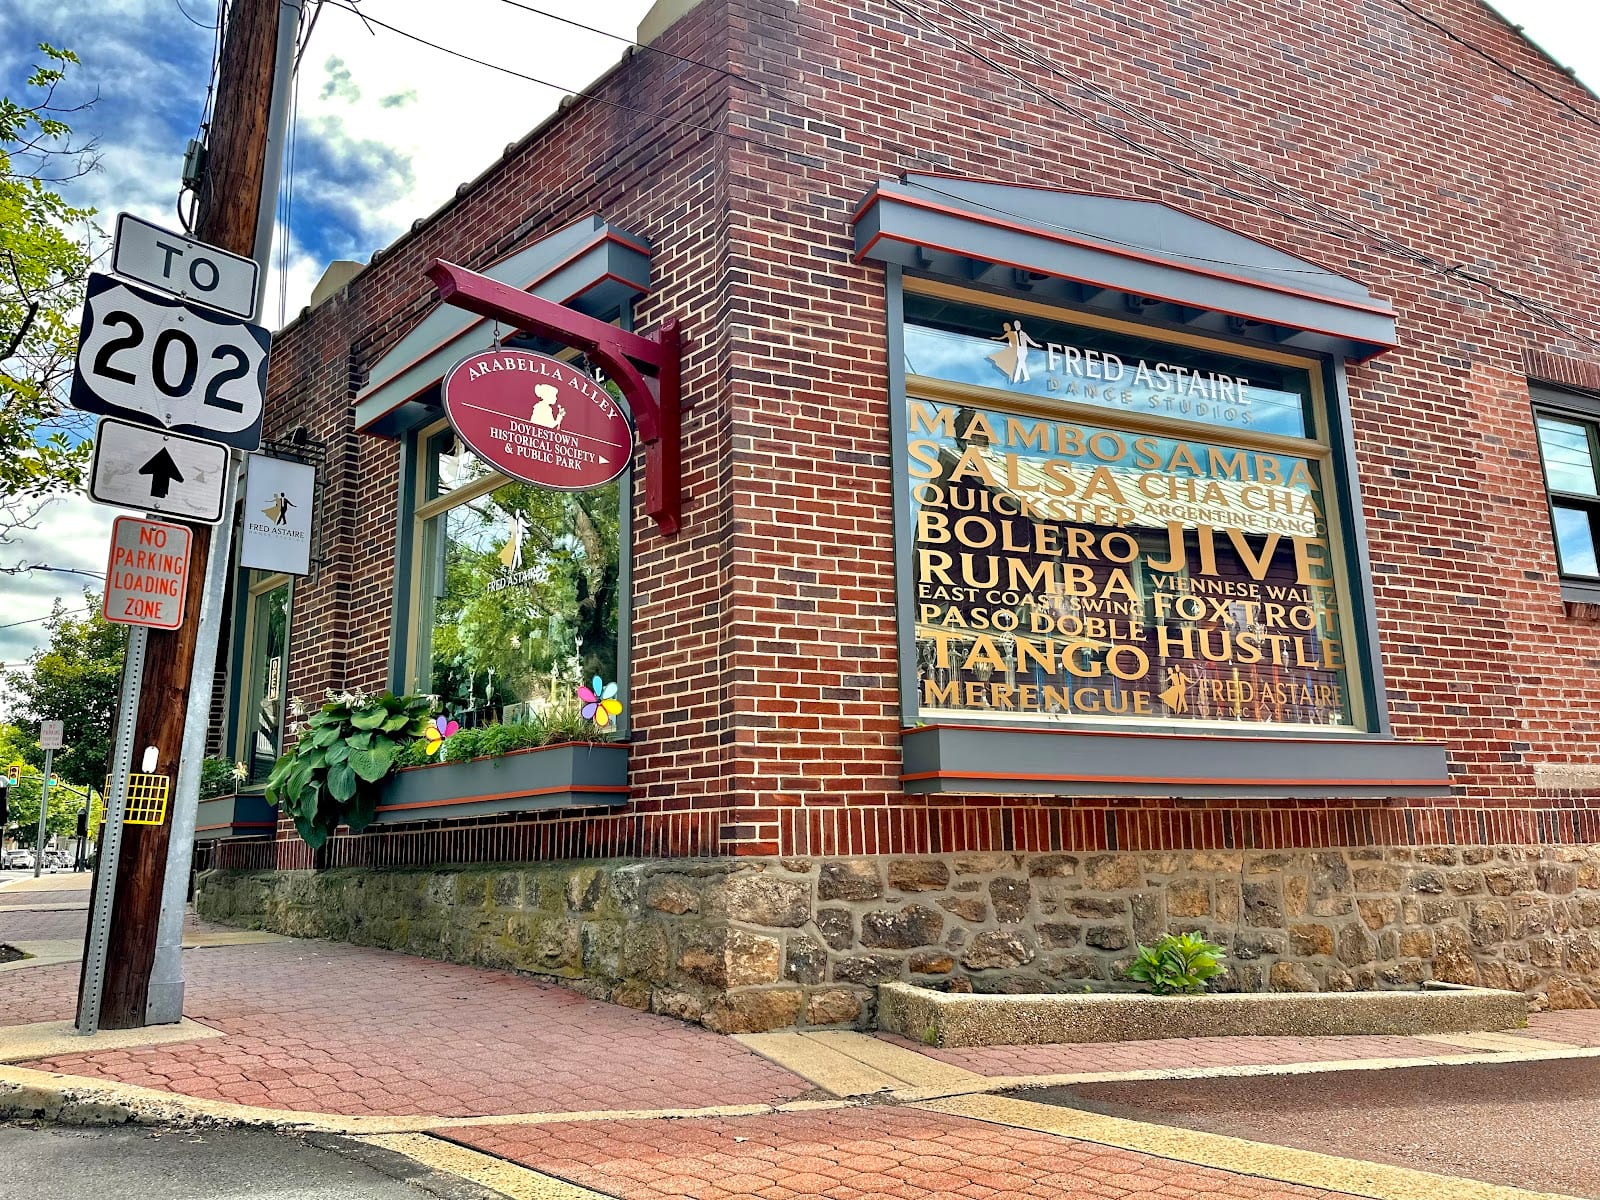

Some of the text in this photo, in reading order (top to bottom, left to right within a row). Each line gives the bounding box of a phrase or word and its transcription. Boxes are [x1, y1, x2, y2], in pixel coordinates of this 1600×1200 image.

[156, 241, 220, 292] TO
[93, 310, 250, 414] 202
[1047, 342, 1252, 405] FRED ASTAIRE
[468, 357, 563, 382] ARABELLA
[568, 377, 618, 420] ALLEY
[1047, 376, 1254, 424] DANCE STUDIOS
[490, 427, 595, 463] HISTORICAL SOCIETY
[510, 421, 579, 447] DOYLESTOWN
[908, 401, 1126, 462] MAMBO
[504, 443, 582, 471] & PUBLIC PARK
[907, 439, 1128, 504] SALSA
[1135, 437, 1320, 491] SAMBA
[912, 482, 1136, 529] QUICKSTEP
[1138, 472, 1324, 518] CHA CHA
[139, 526, 167, 548] NO
[249, 522, 270, 533] FRED
[271, 527, 305, 539] ASTAIRE
[917, 511, 1140, 564] BOLERO
[1142, 502, 1327, 534] ARGENTINE TANGO
[115, 547, 183, 575] PARKING
[1146, 520, 1334, 588] JIVE
[114, 571, 178, 597] LOADING
[487, 577, 506, 594] FRED
[918, 549, 1141, 601] RUMBA
[1150, 574, 1260, 598] VIENNESE
[124, 598, 163, 619] ZONE
[918, 583, 1146, 617] EAST COAST SWING
[1153, 591, 1340, 633] FOXTROT
[919, 603, 1147, 642] PASO DOBLE
[919, 630, 1150, 681] TANGO
[1155, 625, 1346, 670] HUSTLE
[270, 660, 278, 699] OPEN
[923, 679, 1153, 714] MERENGUE
[1200, 679, 1345, 707] FRED ASTAIRE
